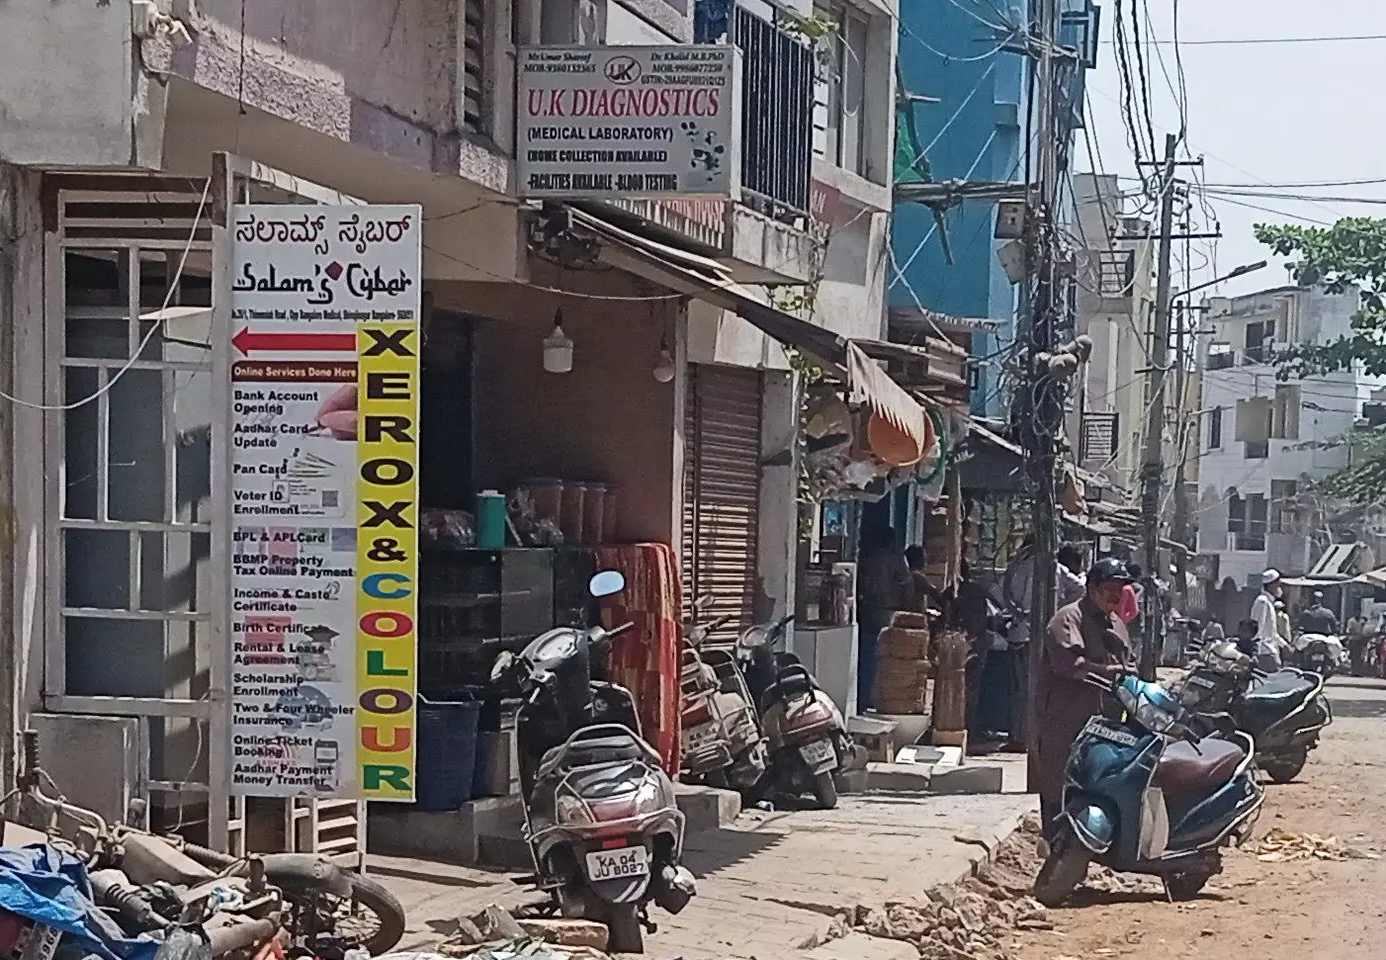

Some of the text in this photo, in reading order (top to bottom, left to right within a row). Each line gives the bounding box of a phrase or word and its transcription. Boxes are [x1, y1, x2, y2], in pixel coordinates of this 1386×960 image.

[528, 88, 719, 117] U.K DIAGNOSTICS
[528, 127, 673, 143] (MEDICAL LABORATORY)
[560, 150, 613, 162] COLLECTION
[572, 173, 612, 190] AVAILABLE
[645, 174, 677, 190] TESTING
[338, 213, 412, 253] ಸೈಬರ್
[234, 366, 356, 377] Online Services Done Here
[234, 390, 318, 401] Bank Account
[234, 403, 284, 415] Opening
[234, 423, 308, 433] Aadhar Card
[234, 437, 277, 449] Update
[234, 463, 287, 475] Pan Card
[270, 491, 282, 500] ID
[234, 505, 300, 515] Enrollment
[233, 533, 257, 542] BPL
[260, 533, 269, 542] &
[233, 555, 323, 567] BBMP Property
[359, 329, 415, 790] XEROX & COLOUR
[234, 566, 353, 578] Tax Online Payment
[234, 589, 330, 600] Income & Caste
[234, 602, 297, 612] Certificate
[233, 623, 262, 633] Birth
[234, 643, 325, 654] Rental & Lease
[234, 655, 300, 666] Agreement
[233, 673, 304, 686] Scholarship
[233, 686, 298, 697] Enrollment
[234, 703, 355, 715] Two & Four Wheeler
[233, 716, 292, 726] Insurance
[234, 735, 313, 746] Online Ticket
[234, 747, 283, 759] Booking
[234, 764, 333, 777] Aadhar Payment
[233, 776, 326, 787] Money Transfer
[599, 853, 636, 867] KA 04
[594, 866, 610, 878] JU
